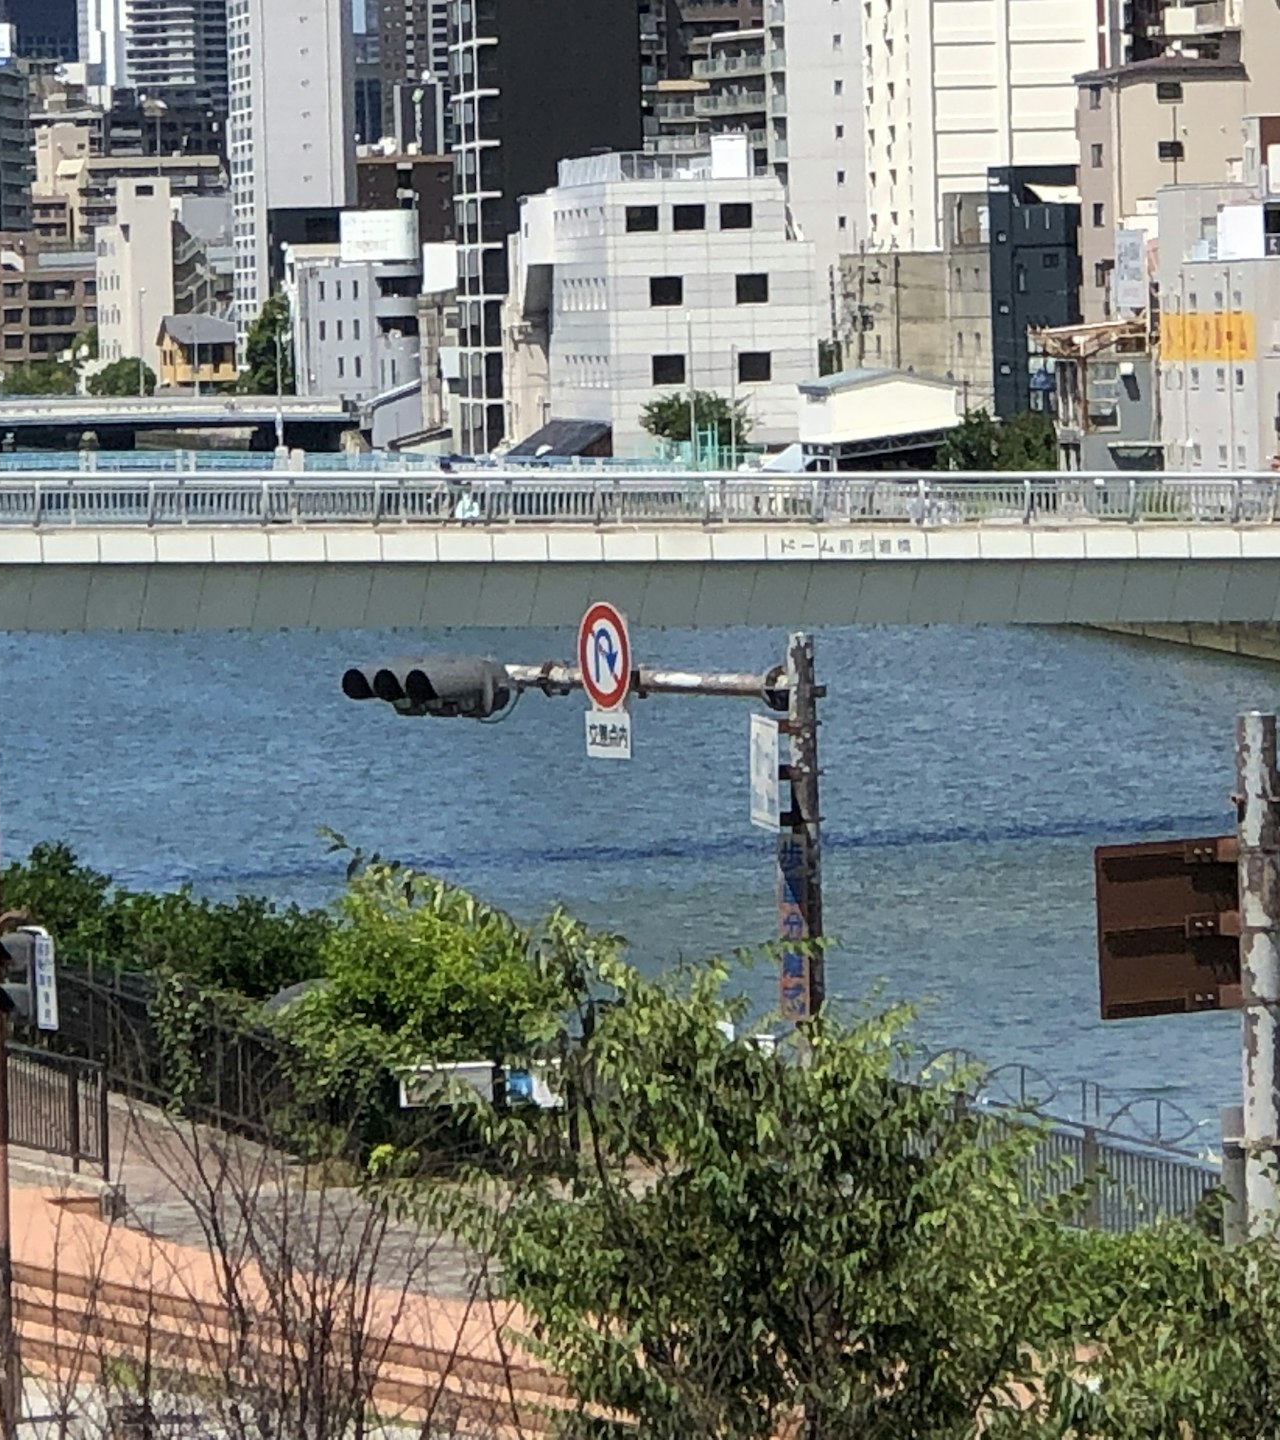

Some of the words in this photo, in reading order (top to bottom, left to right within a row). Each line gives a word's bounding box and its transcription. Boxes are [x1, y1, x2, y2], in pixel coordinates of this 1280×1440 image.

[780, 538, 912, 554] ドーム前歩道橋
[588, 722, 629, 750] 交差点内
